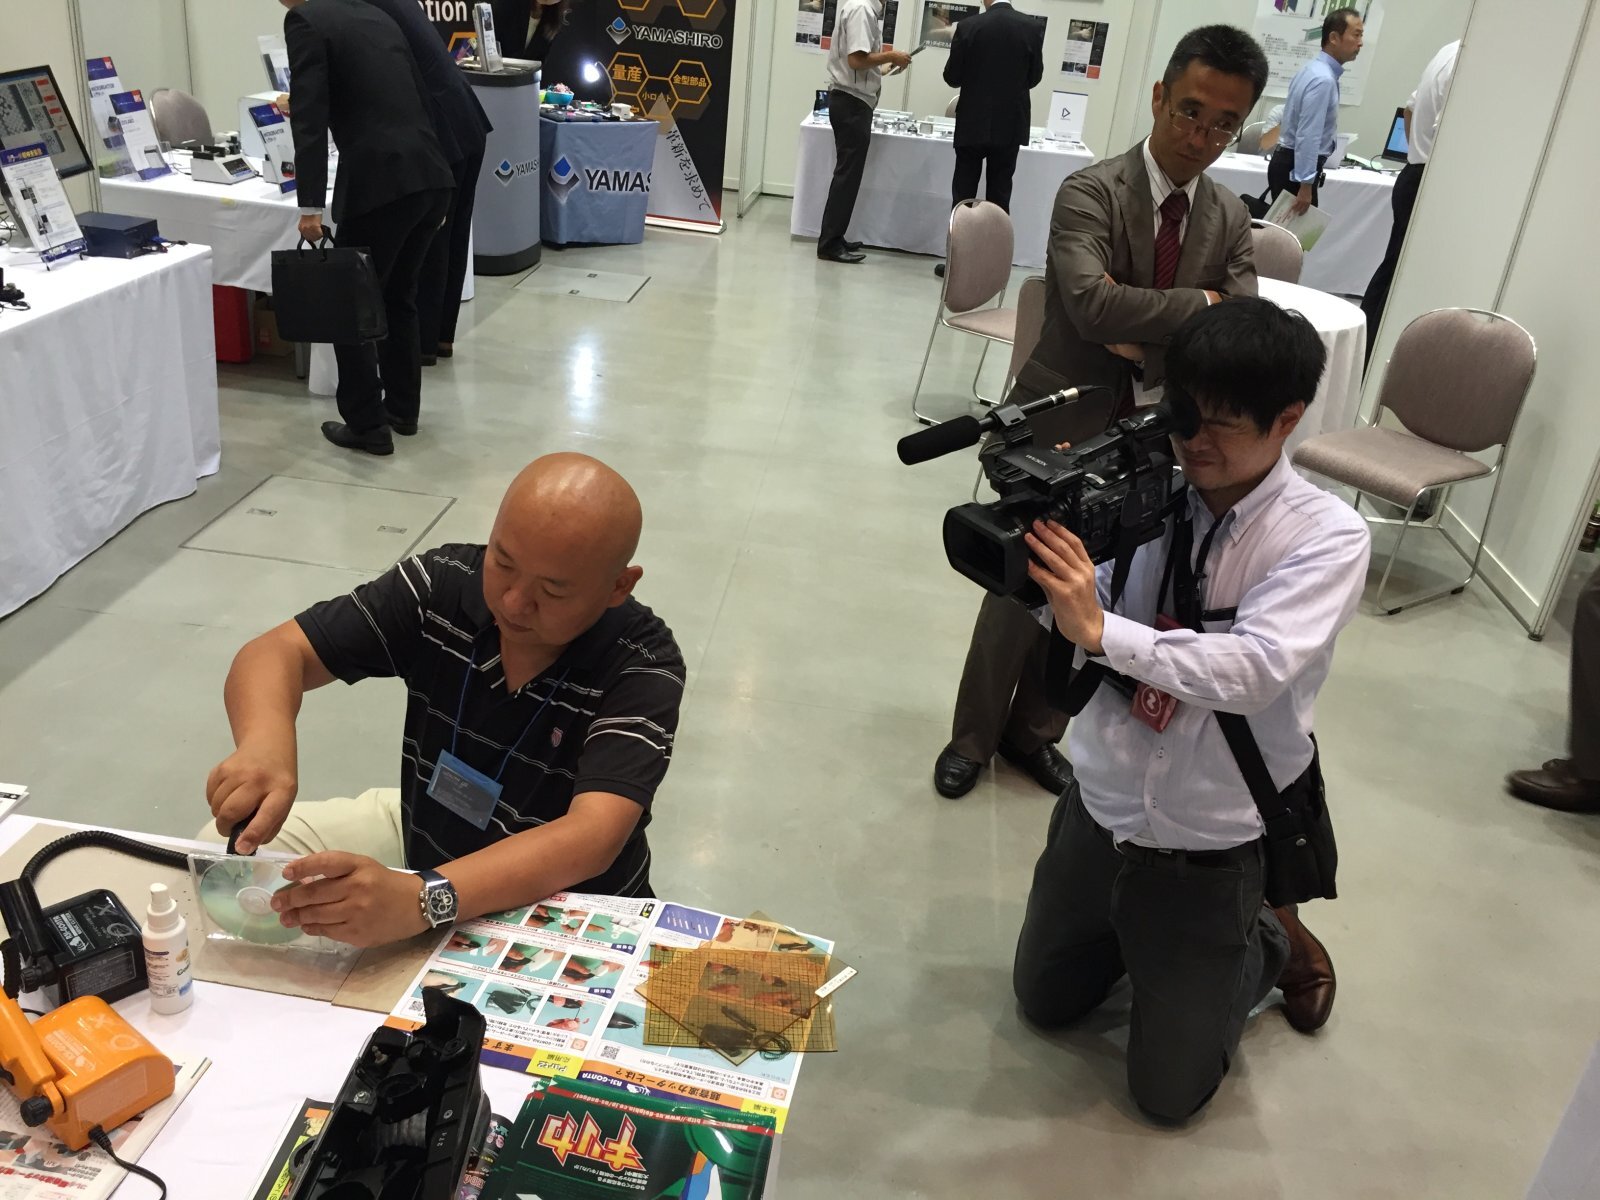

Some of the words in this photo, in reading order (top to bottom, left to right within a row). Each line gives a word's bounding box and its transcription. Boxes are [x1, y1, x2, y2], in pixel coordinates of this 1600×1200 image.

[417, 0, 468, 22] tion
[632, 25, 723, 49] YAMASHIRO
[611, 64, 643, 83] 量産
[672, 75, 708, 88] 金型部品
[515, 159, 539, 177] YAMAS
[537, 1110, 647, 1172] キリカ
